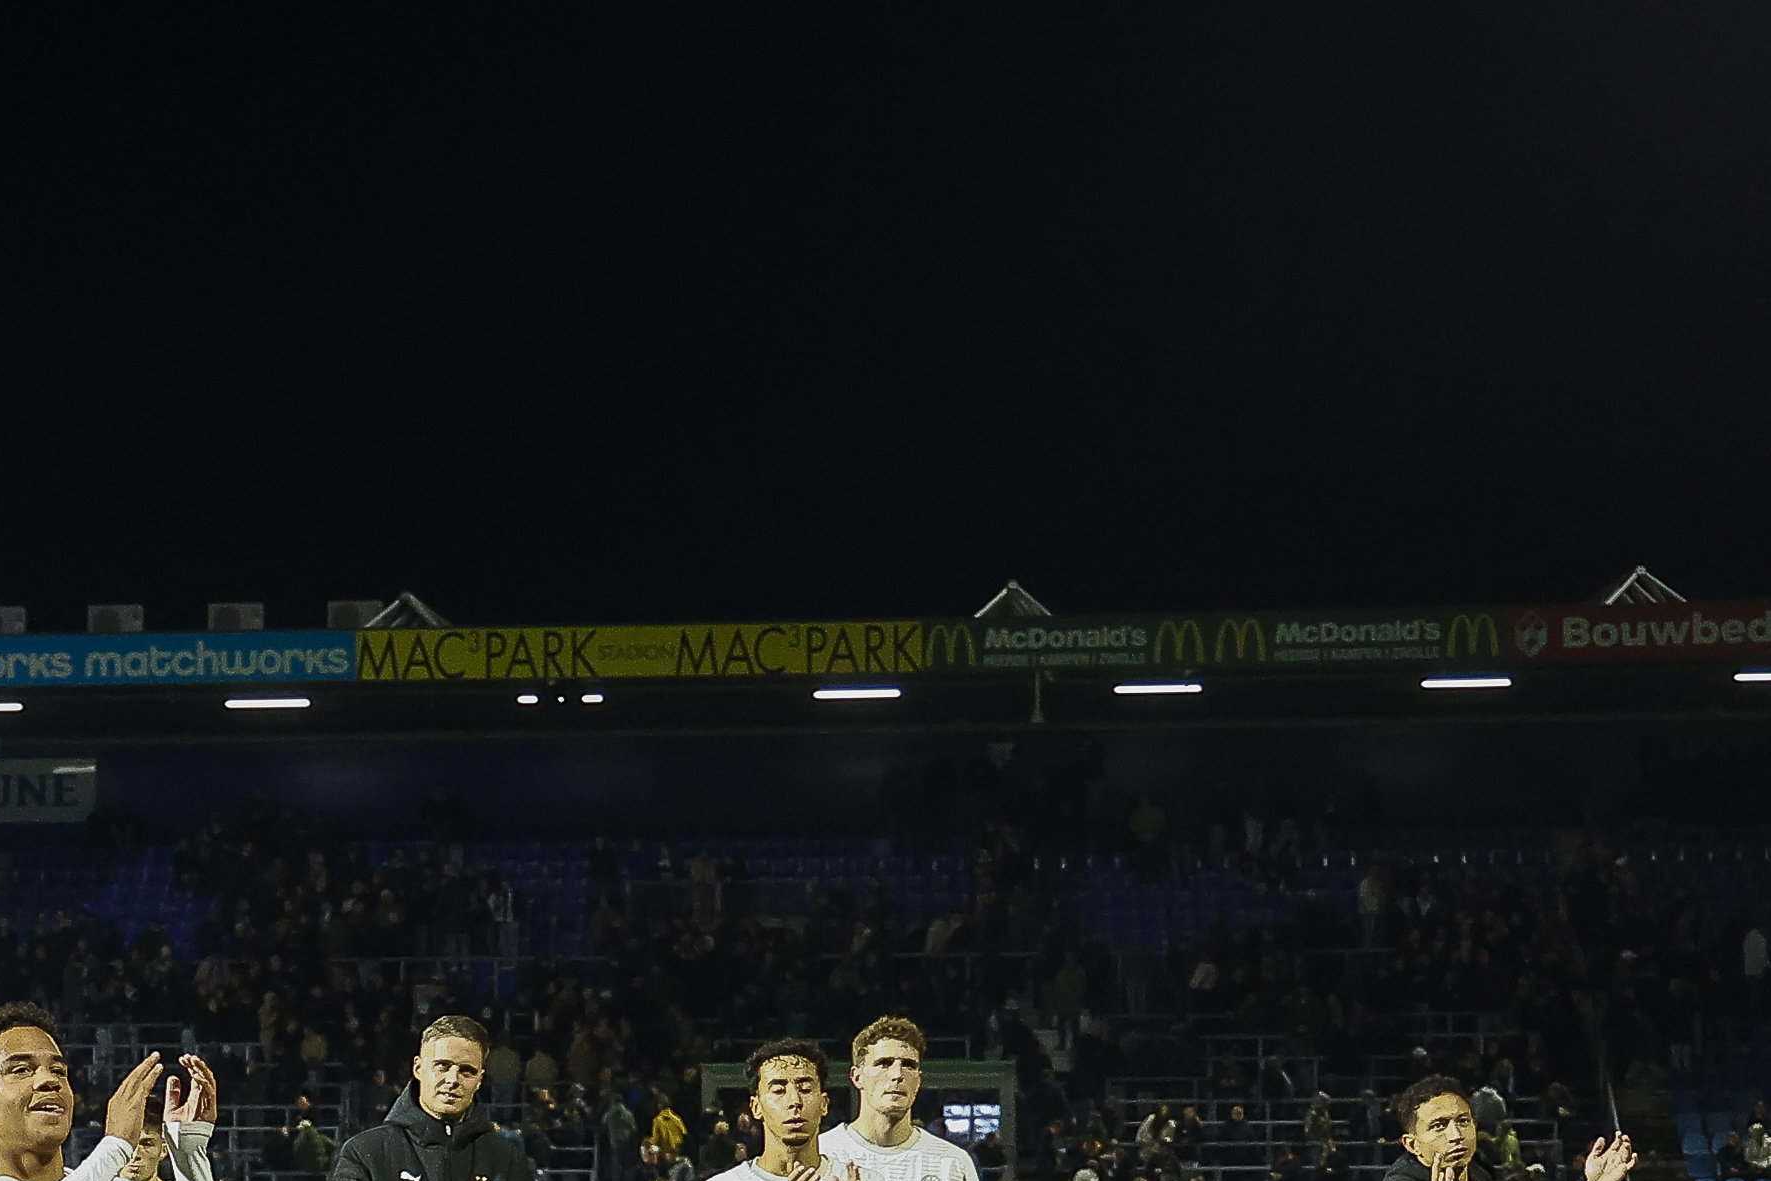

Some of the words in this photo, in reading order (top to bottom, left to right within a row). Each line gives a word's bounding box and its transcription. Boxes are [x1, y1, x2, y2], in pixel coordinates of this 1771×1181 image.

[984, 624, 1148, 649] McDonald's
[1276, 620, 1441, 644] McDonald's
[85, 640, 350, 678] matchworks
